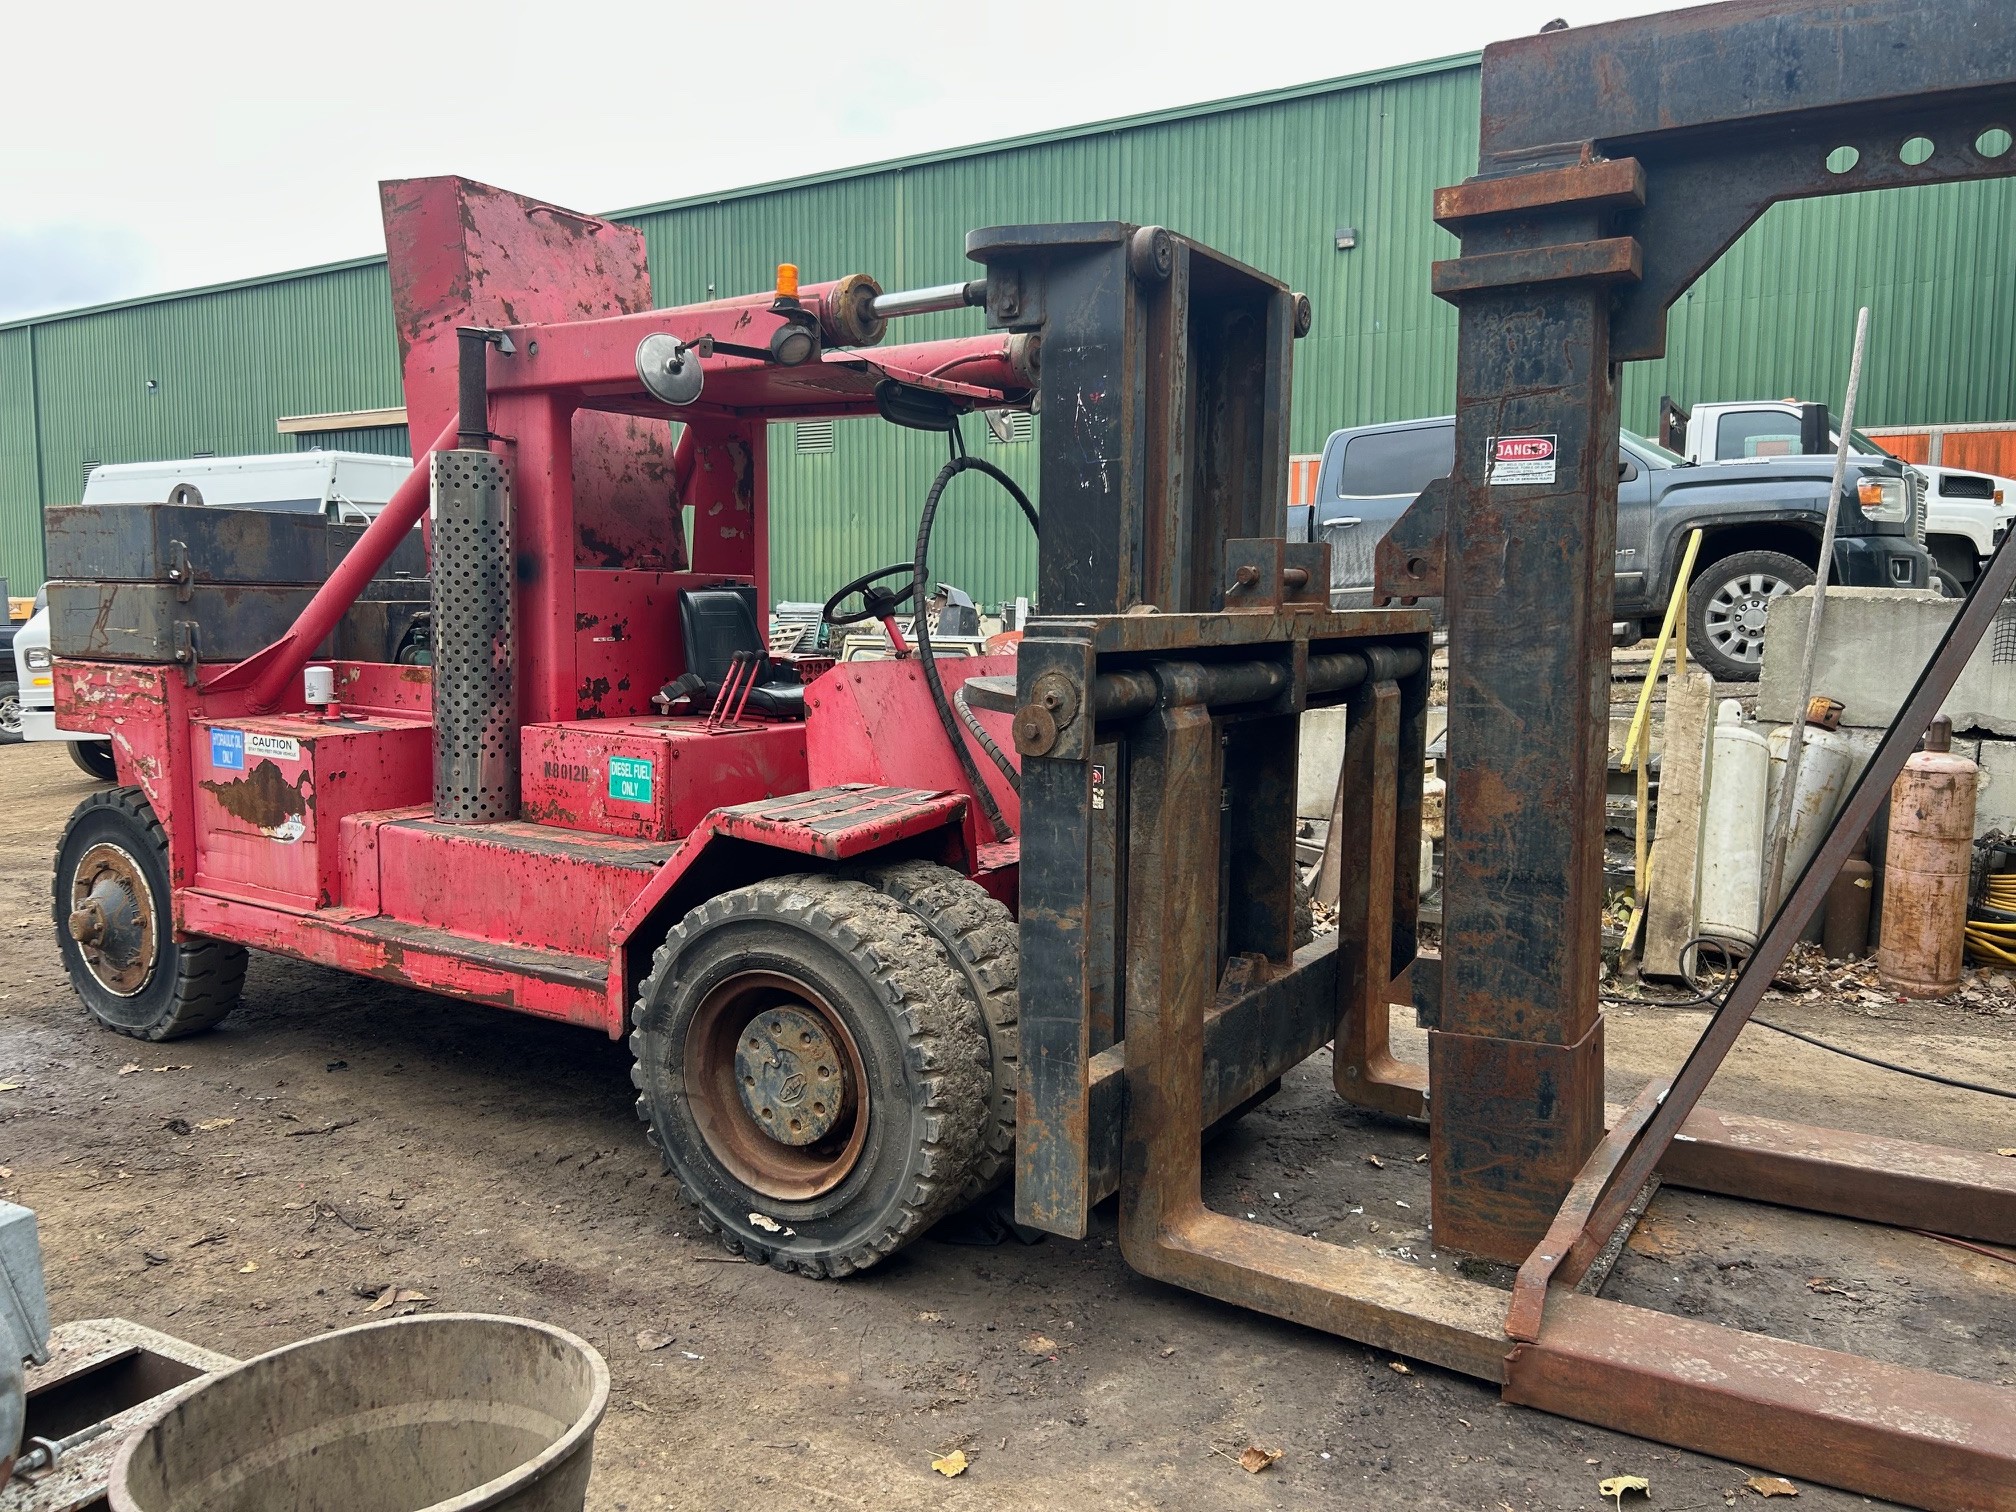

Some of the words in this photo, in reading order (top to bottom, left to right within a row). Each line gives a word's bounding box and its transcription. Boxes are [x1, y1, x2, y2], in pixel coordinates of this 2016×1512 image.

[252, 736, 292, 750] CAUTION
[222, 750, 233, 764] ONLY
[611, 761, 633, 778] DIESEL
[633, 764, 650, 781] FUEL
[621, 780, 639, 797] ONLY
